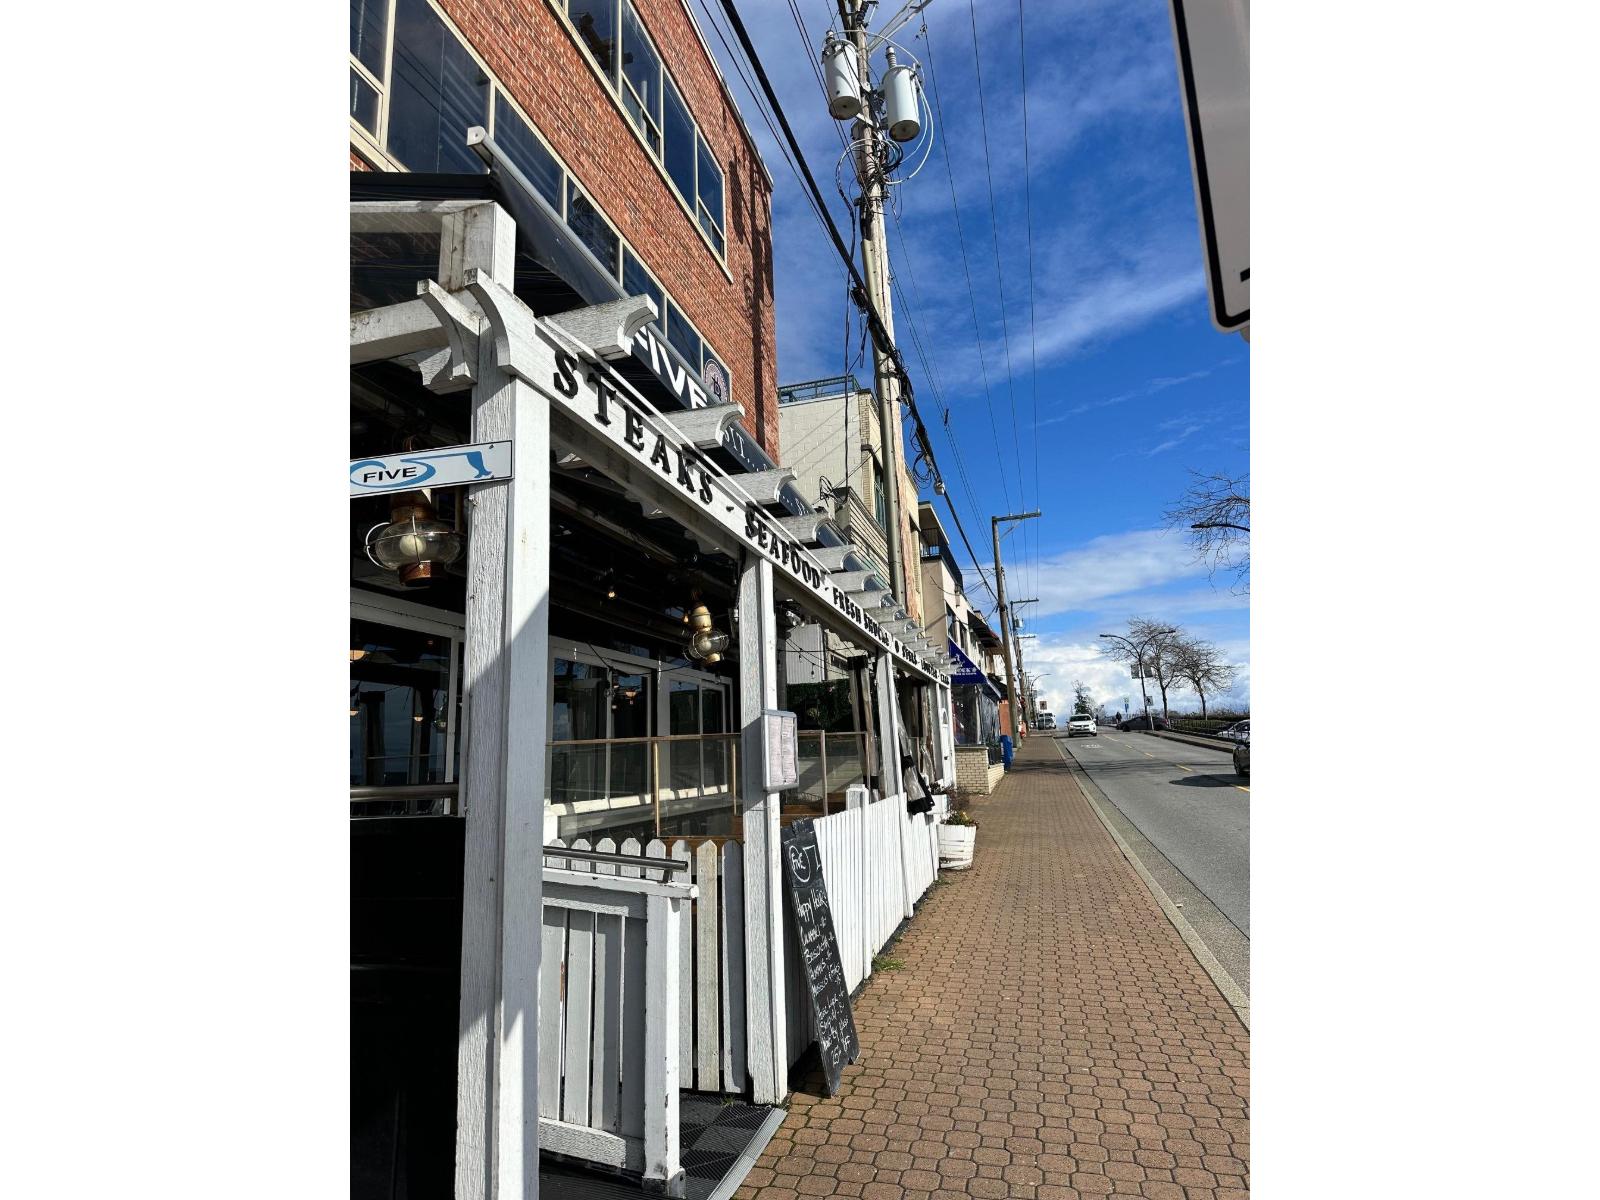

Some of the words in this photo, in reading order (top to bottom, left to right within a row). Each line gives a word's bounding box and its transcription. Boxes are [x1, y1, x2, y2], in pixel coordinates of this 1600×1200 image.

[363, 466, 417, 483] FIVE
[553, 349, 713, 505] STEAKS
[745, 503, 820, 589] SEAFOOD
[832, 586, 862, 624] FRESH
